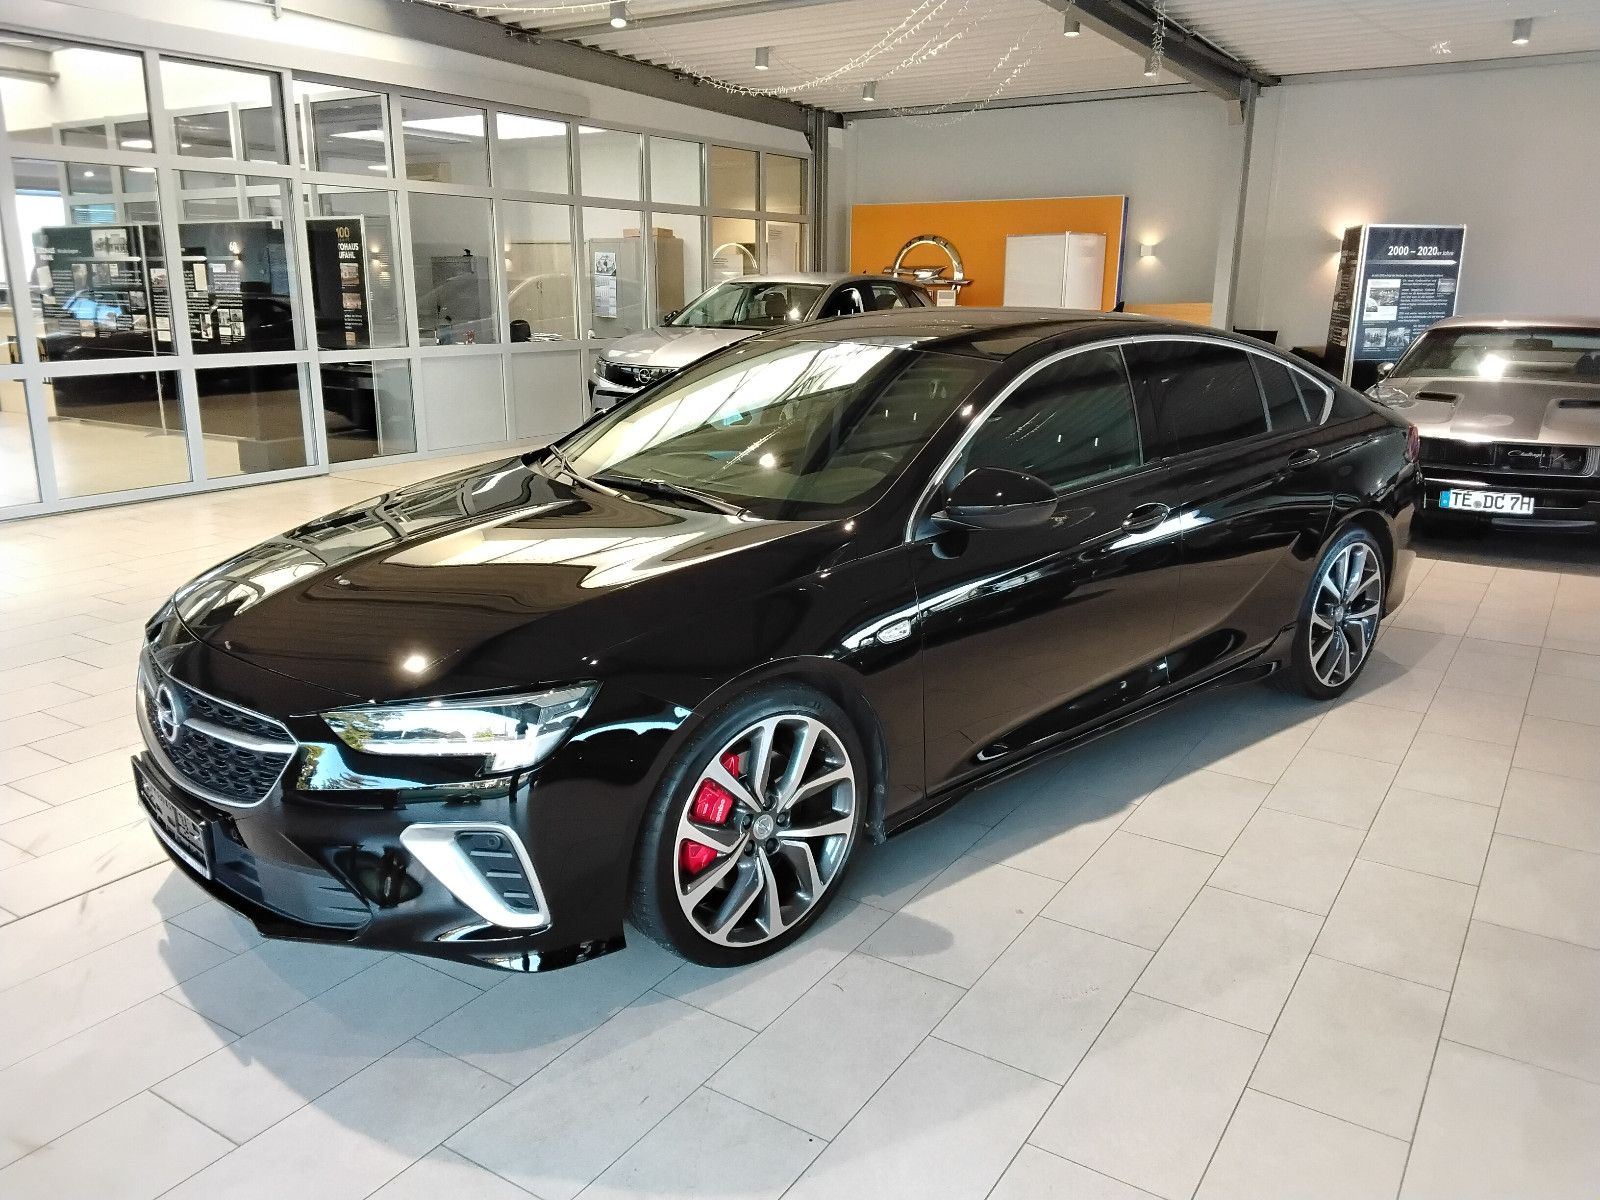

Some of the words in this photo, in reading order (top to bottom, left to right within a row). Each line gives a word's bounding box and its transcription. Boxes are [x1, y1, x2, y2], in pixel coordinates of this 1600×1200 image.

[335, 226, 350, 238] 100
[1387, 245, 1409, 256] 2000
[1452, 490, 1472, 507] TE
[1483, 493, 1505, 510] DC
[1510, 496, 1531, 511] 7H
